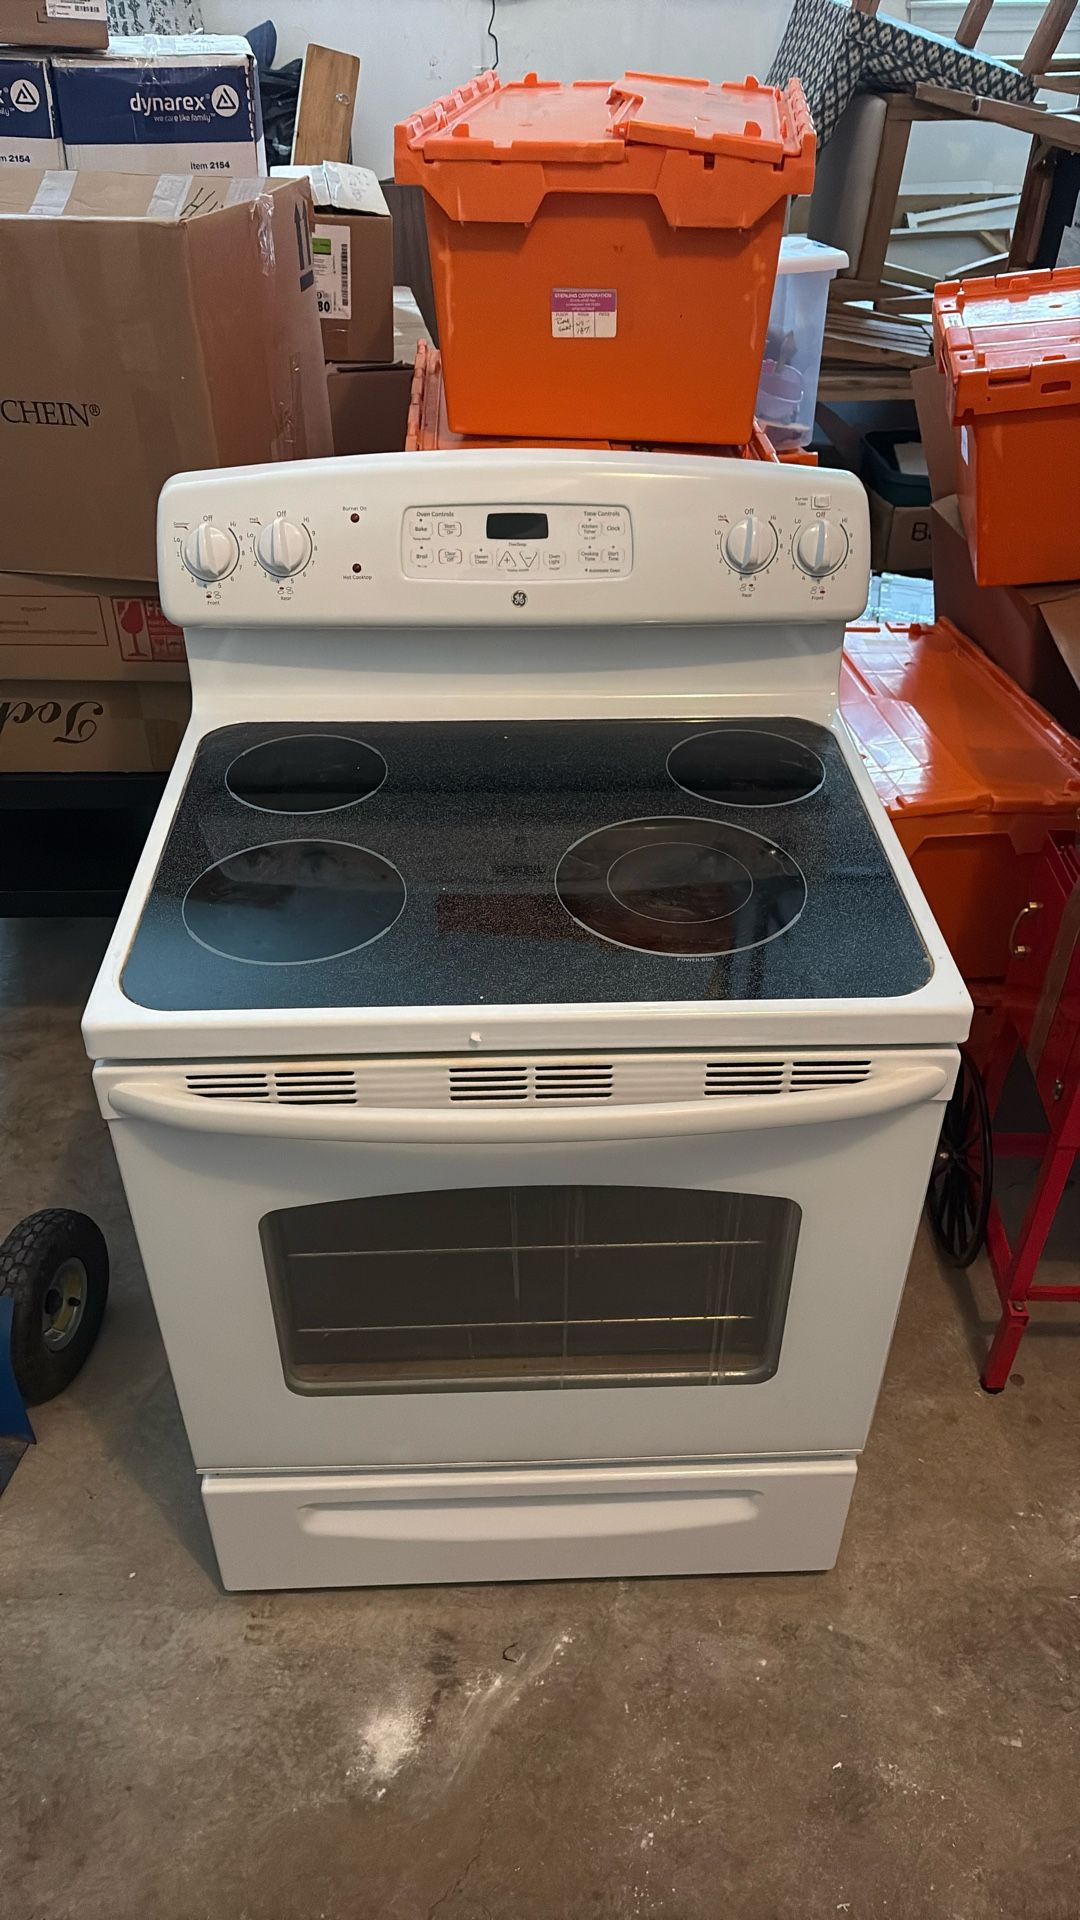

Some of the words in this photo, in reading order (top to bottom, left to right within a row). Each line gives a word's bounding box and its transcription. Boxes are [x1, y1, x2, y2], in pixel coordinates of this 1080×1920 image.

[179, 114, 191, 122] like
[8, 155, 30, 163] 2154
[190, 161, 208, 170] Item
[209, 161, 230, 169] 2154
